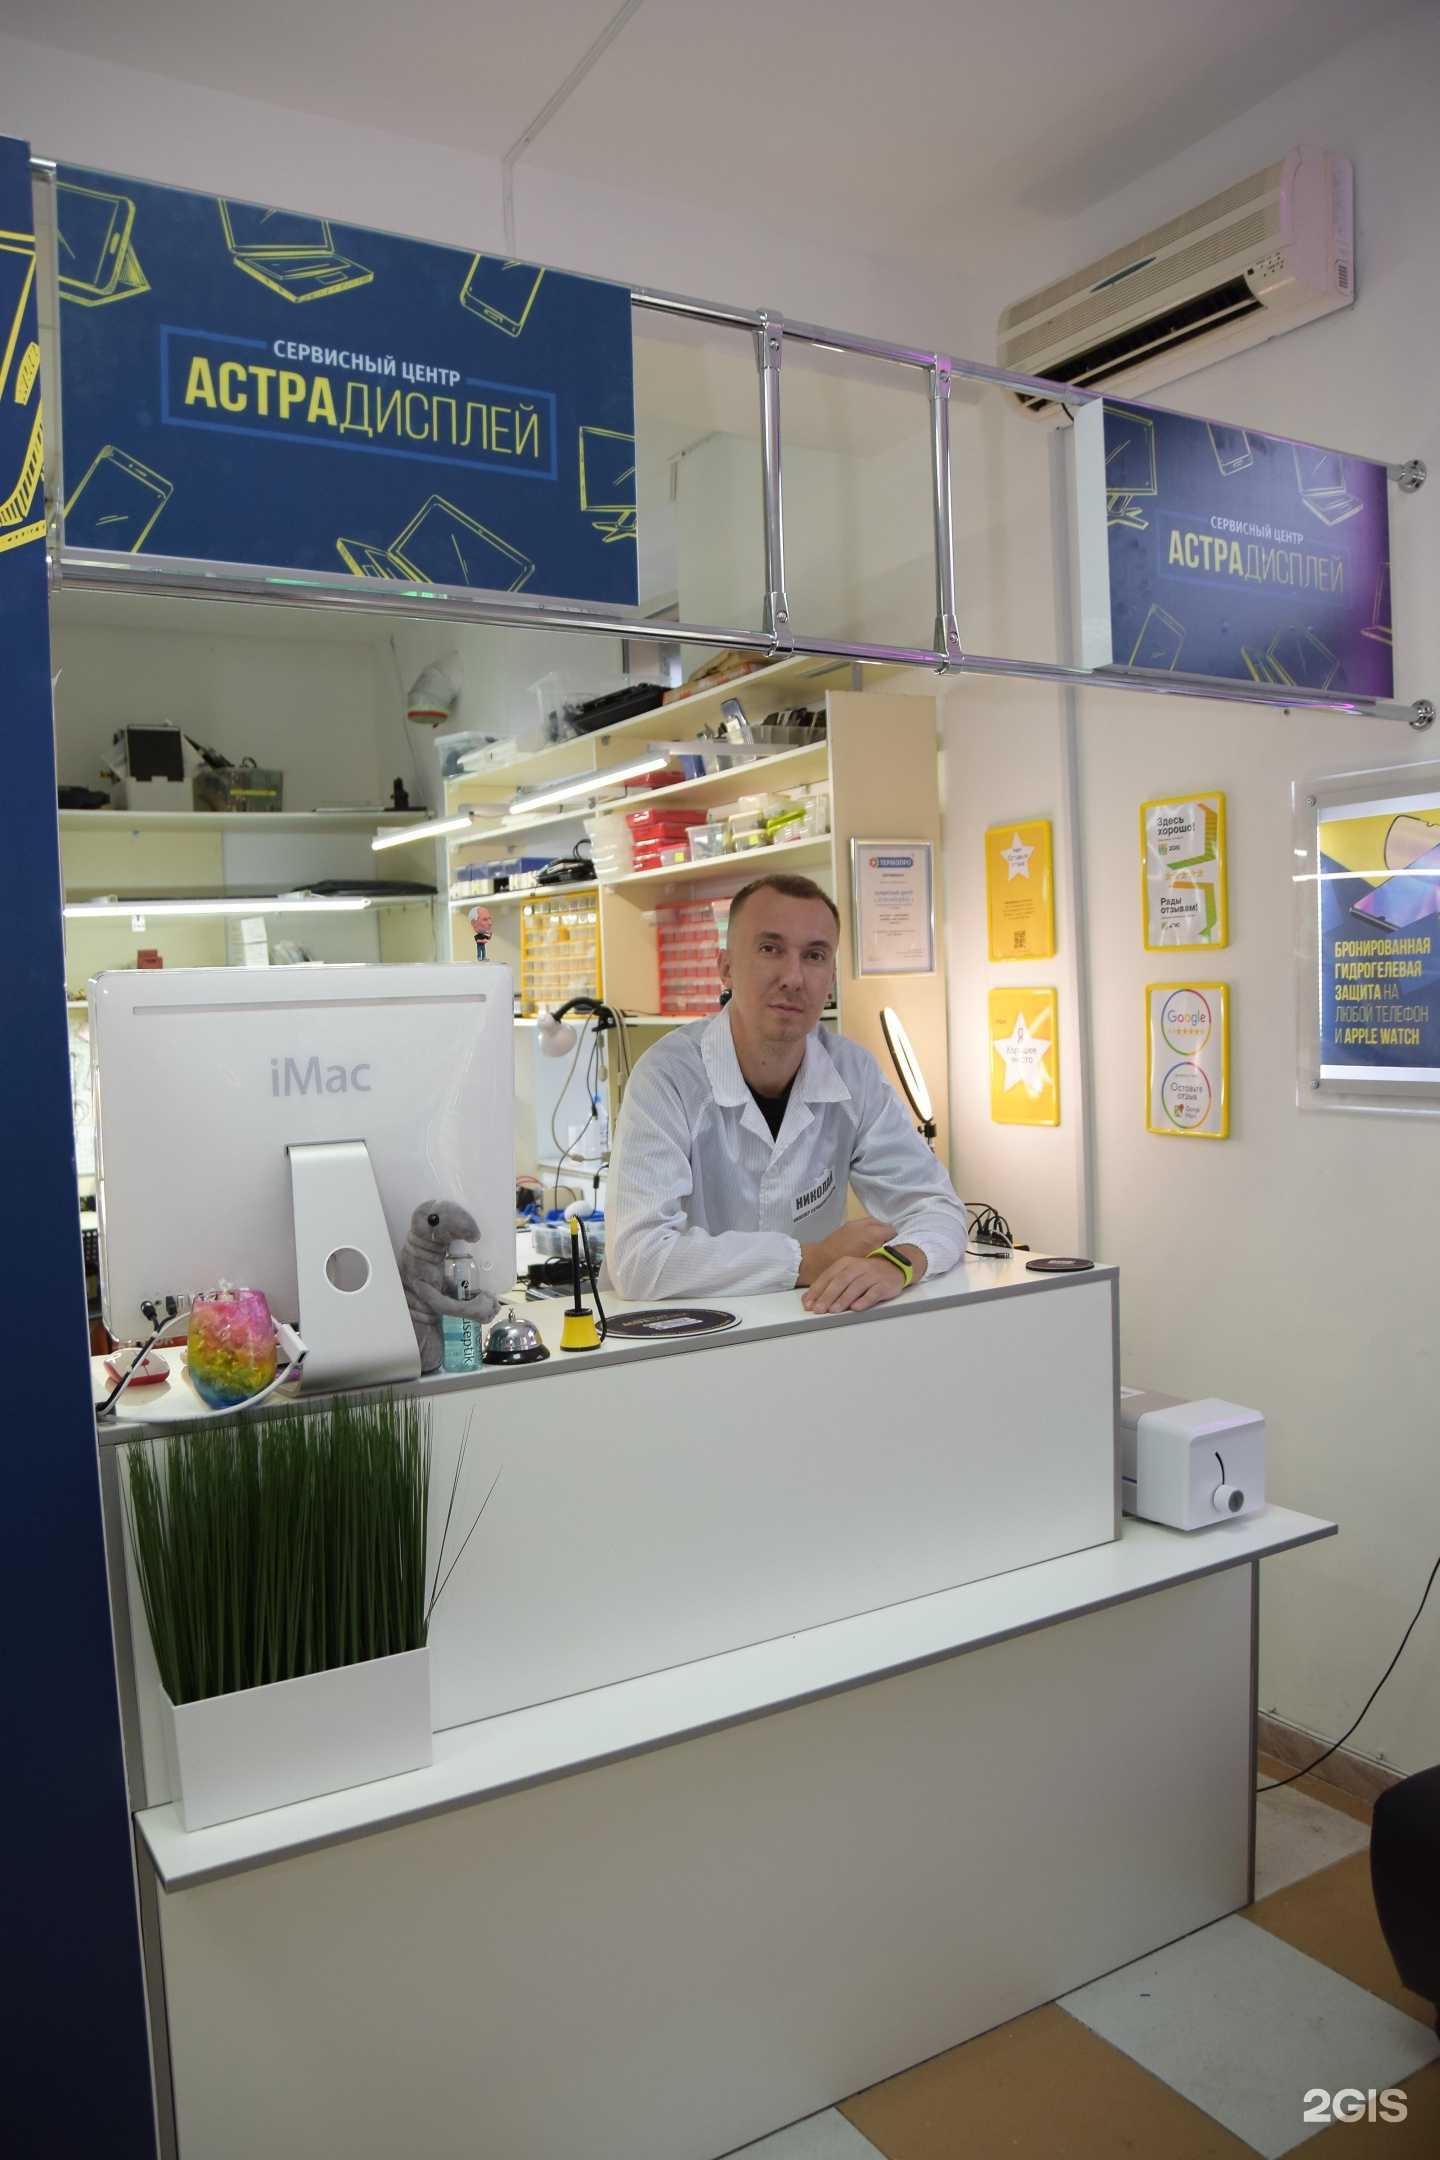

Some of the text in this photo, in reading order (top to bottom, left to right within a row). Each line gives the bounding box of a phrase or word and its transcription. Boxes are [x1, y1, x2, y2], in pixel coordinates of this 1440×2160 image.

[273, 339, 461, 387] СЕРВИСНЫЙ ЦЕНТР
[184, 355, 540, 458] АСТРАДИСПЛЕЙ
[1210, 515, 1304, 545] СЕРВИСНЫЙ ЦЕНТР
[1168, 529, 1344, 593] АСТРАДИСПЛЕЙ
[1157, 816, 1184, 827] Здесь
[1160, 897, 1182, 908] Рады
[1335, 937, 1431, 957] БРОНИРОВАННАЯ
[1335, 960, 1422, 980] ГИДРОГЕЛЕВАЯ
[1335, 983, 1399, 1002] ЗАЩИТА НА
[1168, 1008, 1206, 1026] Google
[1335, 1003, 1429, 1022] ЛЮБОЙ ТЕЛЕФОН
[1335, 1027, 1420, 1045] И APPLE WATCH
[271, 1055, 371, 1097] iMac
